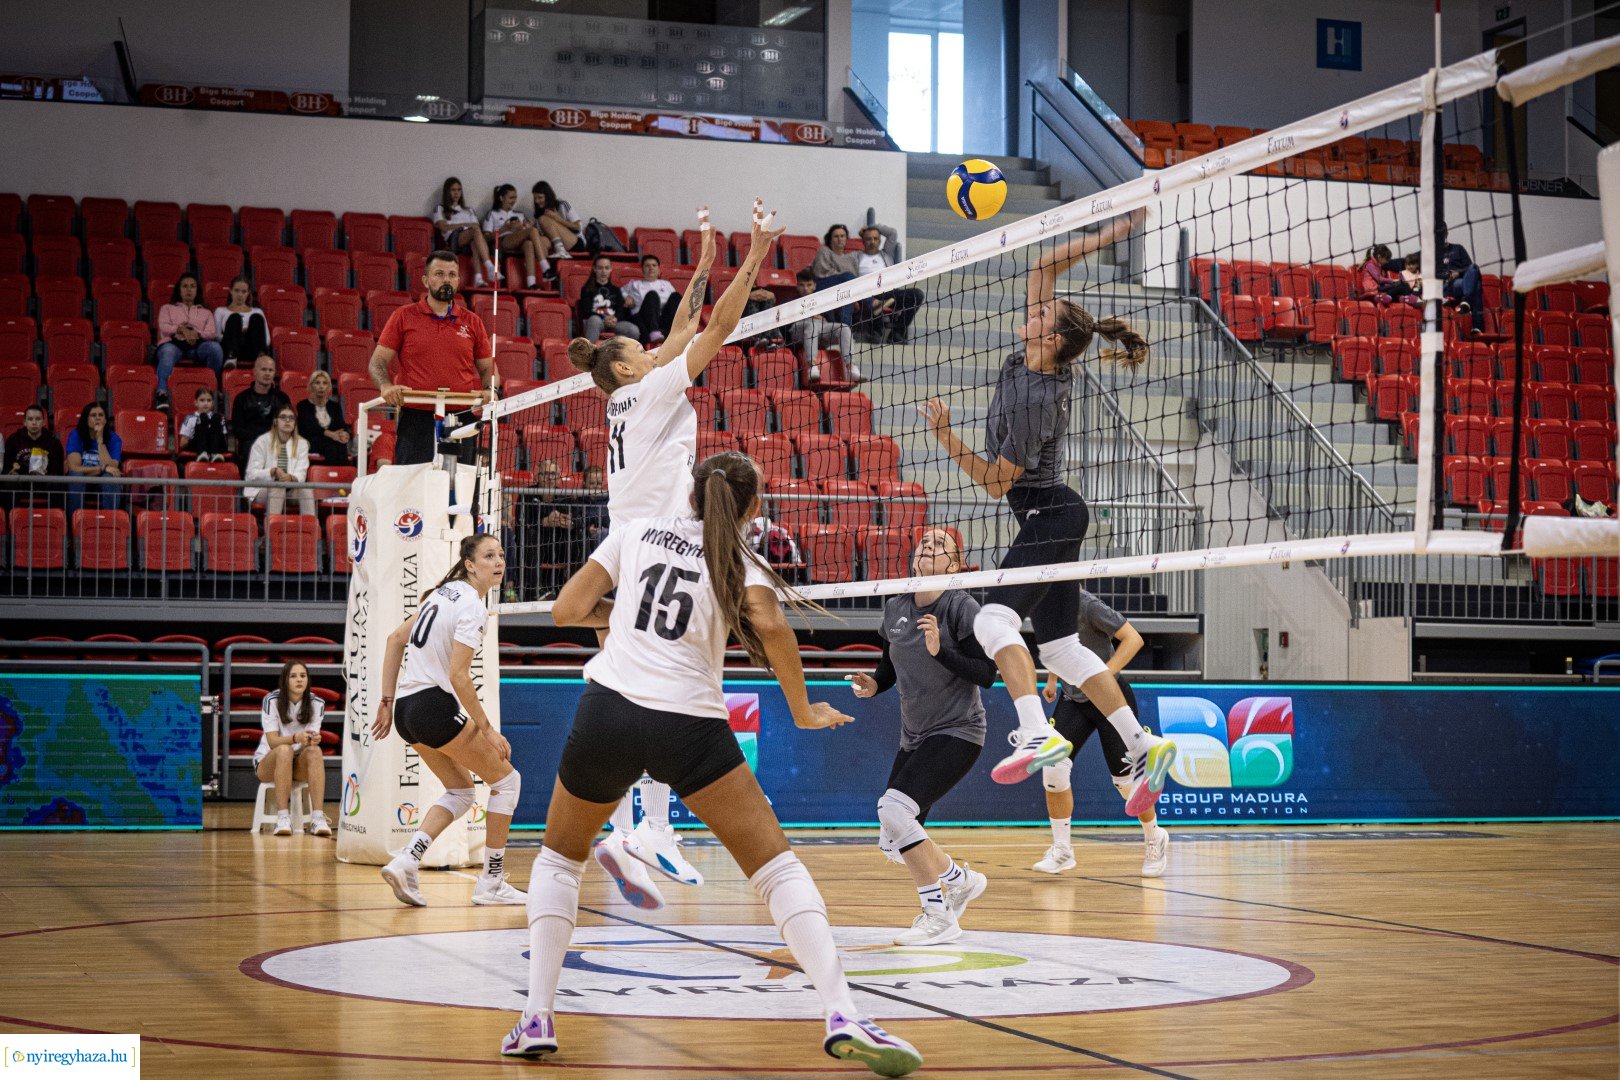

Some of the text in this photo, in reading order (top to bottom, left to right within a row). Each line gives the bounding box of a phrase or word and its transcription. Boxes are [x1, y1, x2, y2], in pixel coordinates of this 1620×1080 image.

[764, 51, 779, 60] BH
[709, 80, 724, 88] BH
[163, 87, 188, 100] BH
[210, 97, 244, 106] Csoport
[297, 96, 321, 109] BH
[428, 104, 452, 117] BH
[473, 111, 506, 121] Csoport
[590, 110, 642, 121] Bige Holding
[555, 110, 580, 124] BH
[600, 120, 632, 129] Csoport
[803, 126, 827, 140] BH
[836, 126, 886, 138] Bige Holding
[845, 137, 876, 145] Csoport
[634, 562, 701, 641] 15
[409, 601, 439, 649] 10
[349, 590, 361, 742] FATUM
[400, 743, 419, 788] FAT
[1158, 793, 1308, 804] GROUP MADURA
[1160, 807, 1308, 815] CORPORATION
[513, 975, 1180, 998] NYÍREYHÁZA
